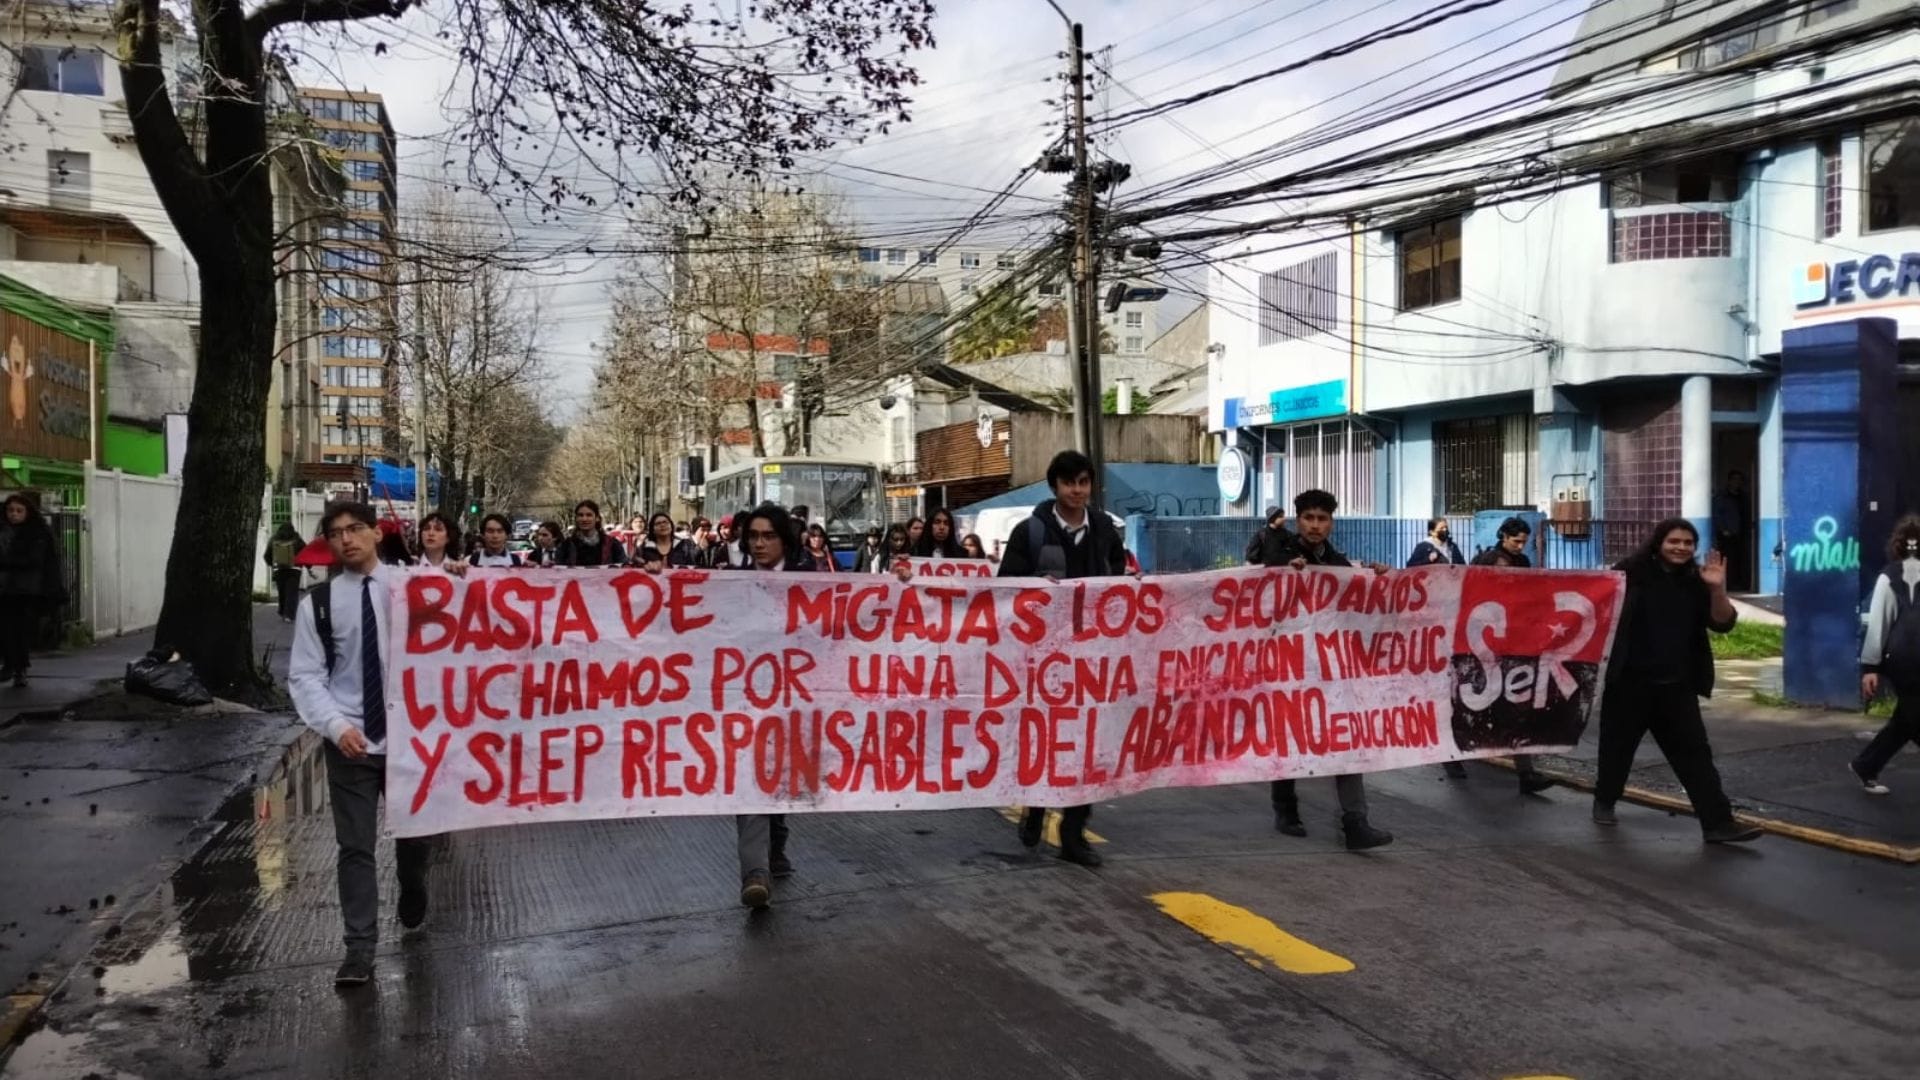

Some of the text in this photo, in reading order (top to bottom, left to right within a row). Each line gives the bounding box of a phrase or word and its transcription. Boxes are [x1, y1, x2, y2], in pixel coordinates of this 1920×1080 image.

[405, 575, 598, 654] BASTA
[609, 571, 714, 639] DE
[1073, 582, 1165, 641] LOS
[1203, 570, 1428, 633] SECUNDARIOS
[403, 653, 693, 730] LUCHAMOS
[712, 648, 817, 711] POR
[849, 654, 957, 700] UNA
[1315, 626, 1447, 681] MINEDUC
[411, 686, 1439, 814] Y SLEP RESPONSABLES DEL ABANDONO EDUCACIÓN
